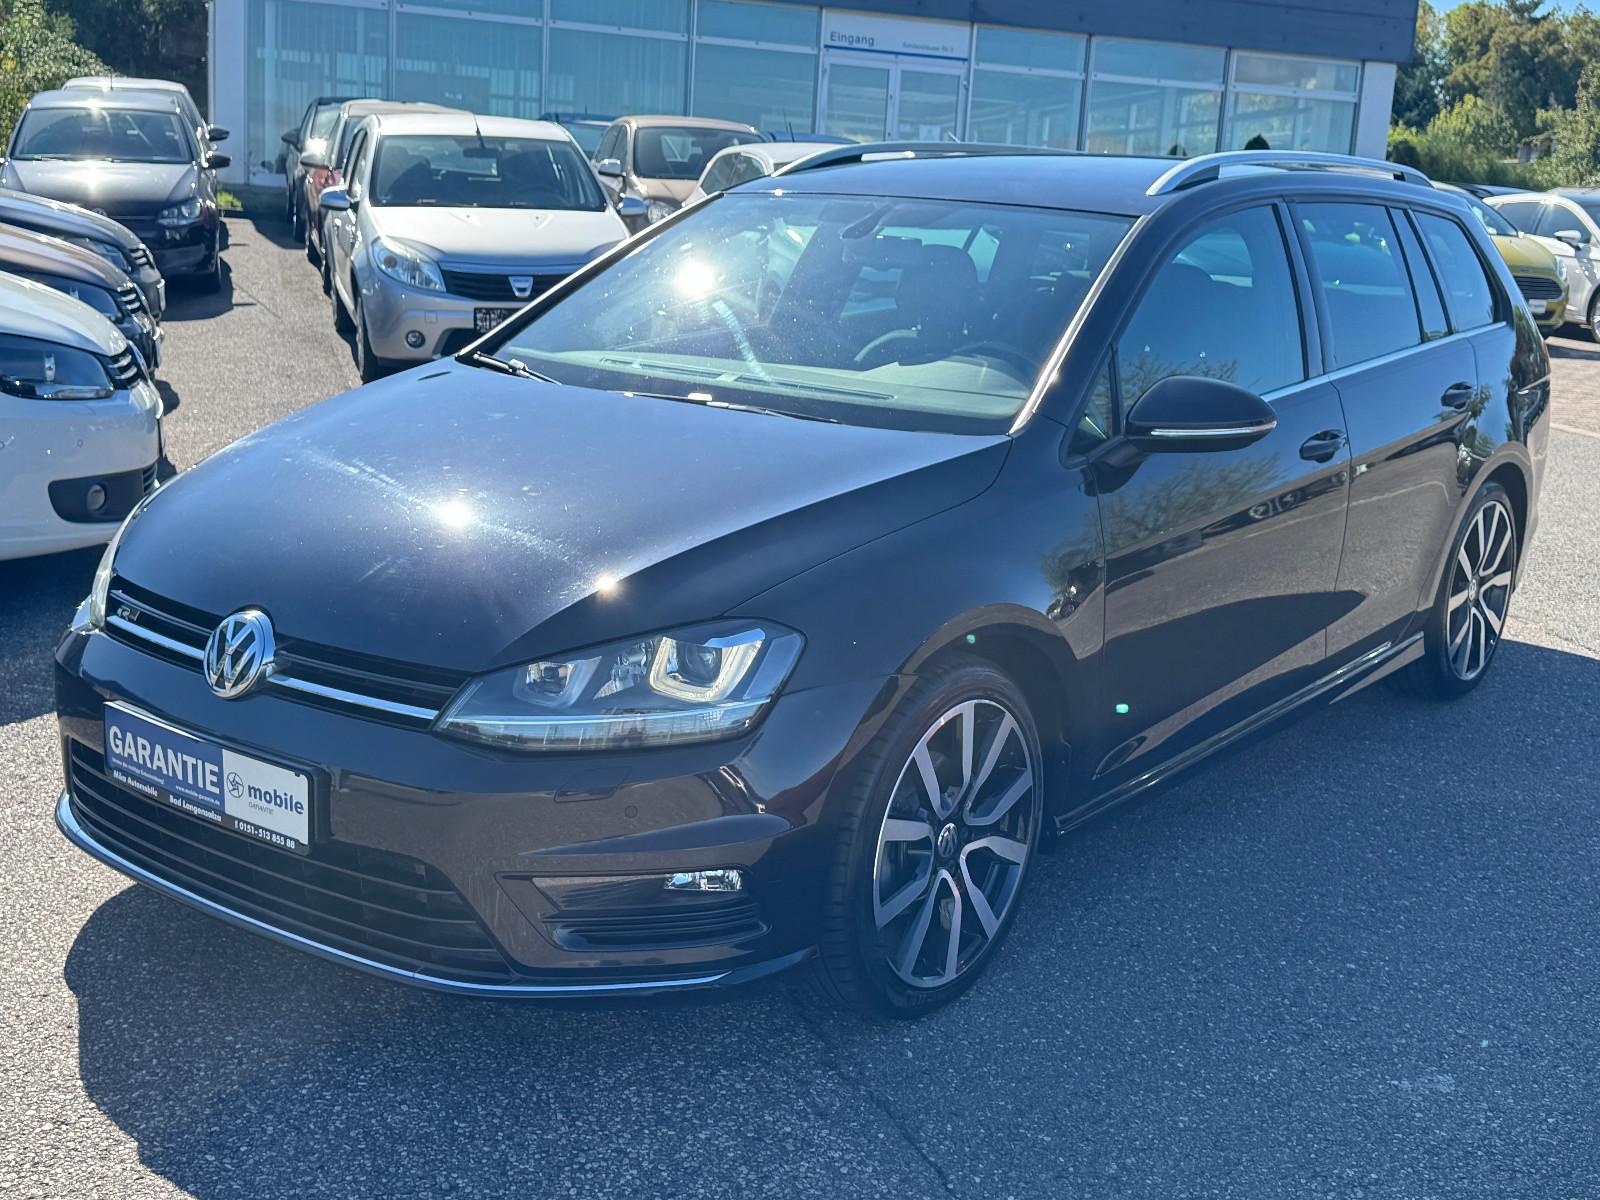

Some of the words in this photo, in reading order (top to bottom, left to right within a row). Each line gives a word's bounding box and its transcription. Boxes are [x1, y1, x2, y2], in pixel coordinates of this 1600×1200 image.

[830, 31, 875, 48] Eingang
[108, 725, 220, 794] GARANTIE
[127, 776, 158, 797] Automobile
[169, 794, 182, 807] Bad
[182, 800, 222, 823] Langensalza
[271, 833, 285, 846] 855
[286, 838, 296, 849] 88
[248, 784, 304, 815] mobile
